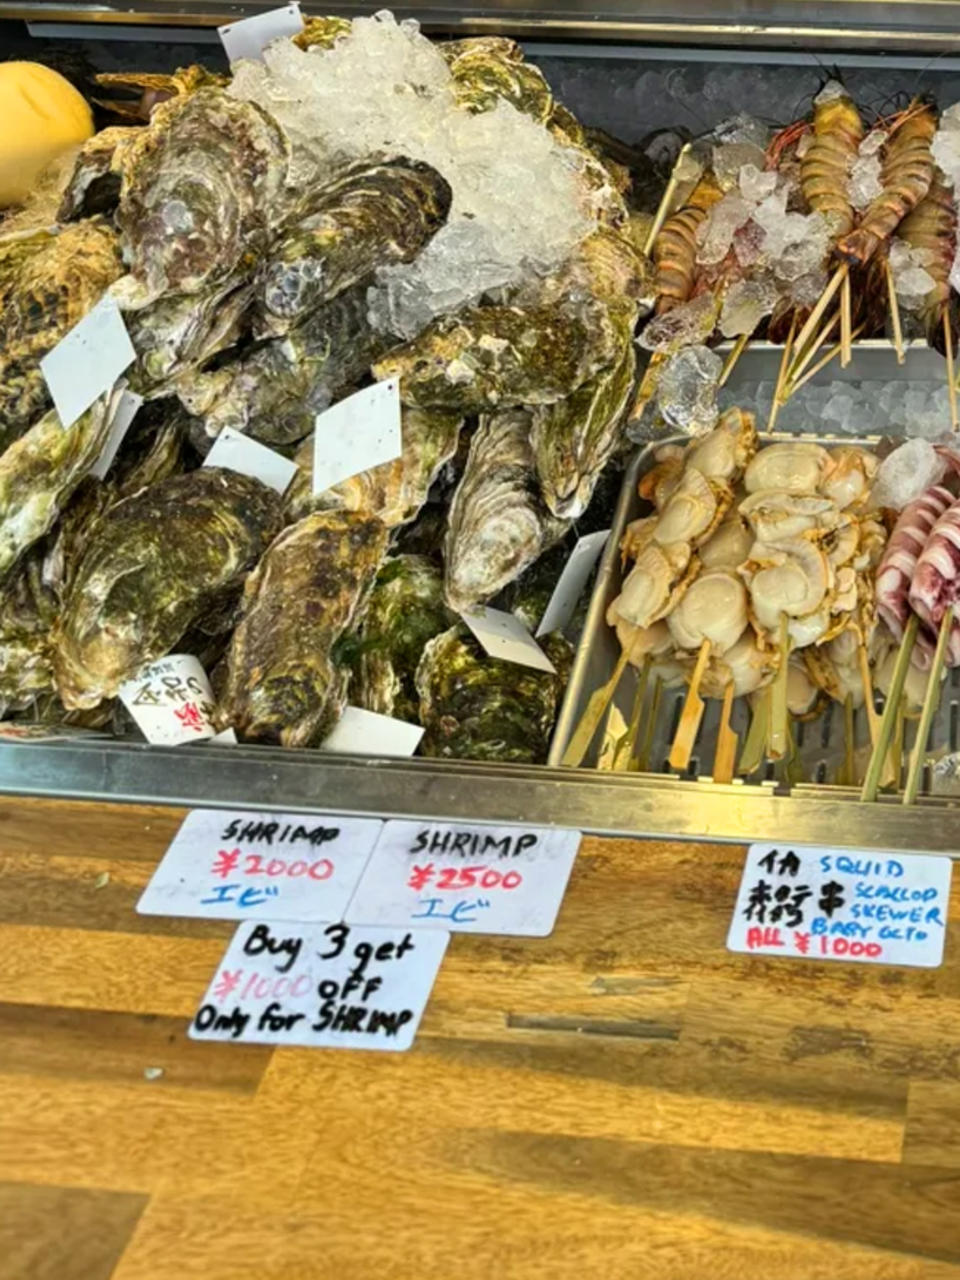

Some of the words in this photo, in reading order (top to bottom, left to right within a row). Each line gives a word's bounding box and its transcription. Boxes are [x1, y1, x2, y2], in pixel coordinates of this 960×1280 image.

[220, 819, 341, 846] SHRIMP
[409, 830, 538, 859] SHRIMP
[210, 847, 335, 881] ¥2000
[407, 863, 524, 892] ¥2500
[819, 855, 905, 878] SQUID
[199, 884, 280, 909] エビ
[410, 898, 492, 922] エビ
[849, 902, 945, 927] SKEWER
[243, 924, 304, 973] Buy
[316, 922, 351, 962] 3
[353, 932, 415, 975] get
[746, 926, 786, 950] ALL
[193, 1003, 250, 1038] Only
